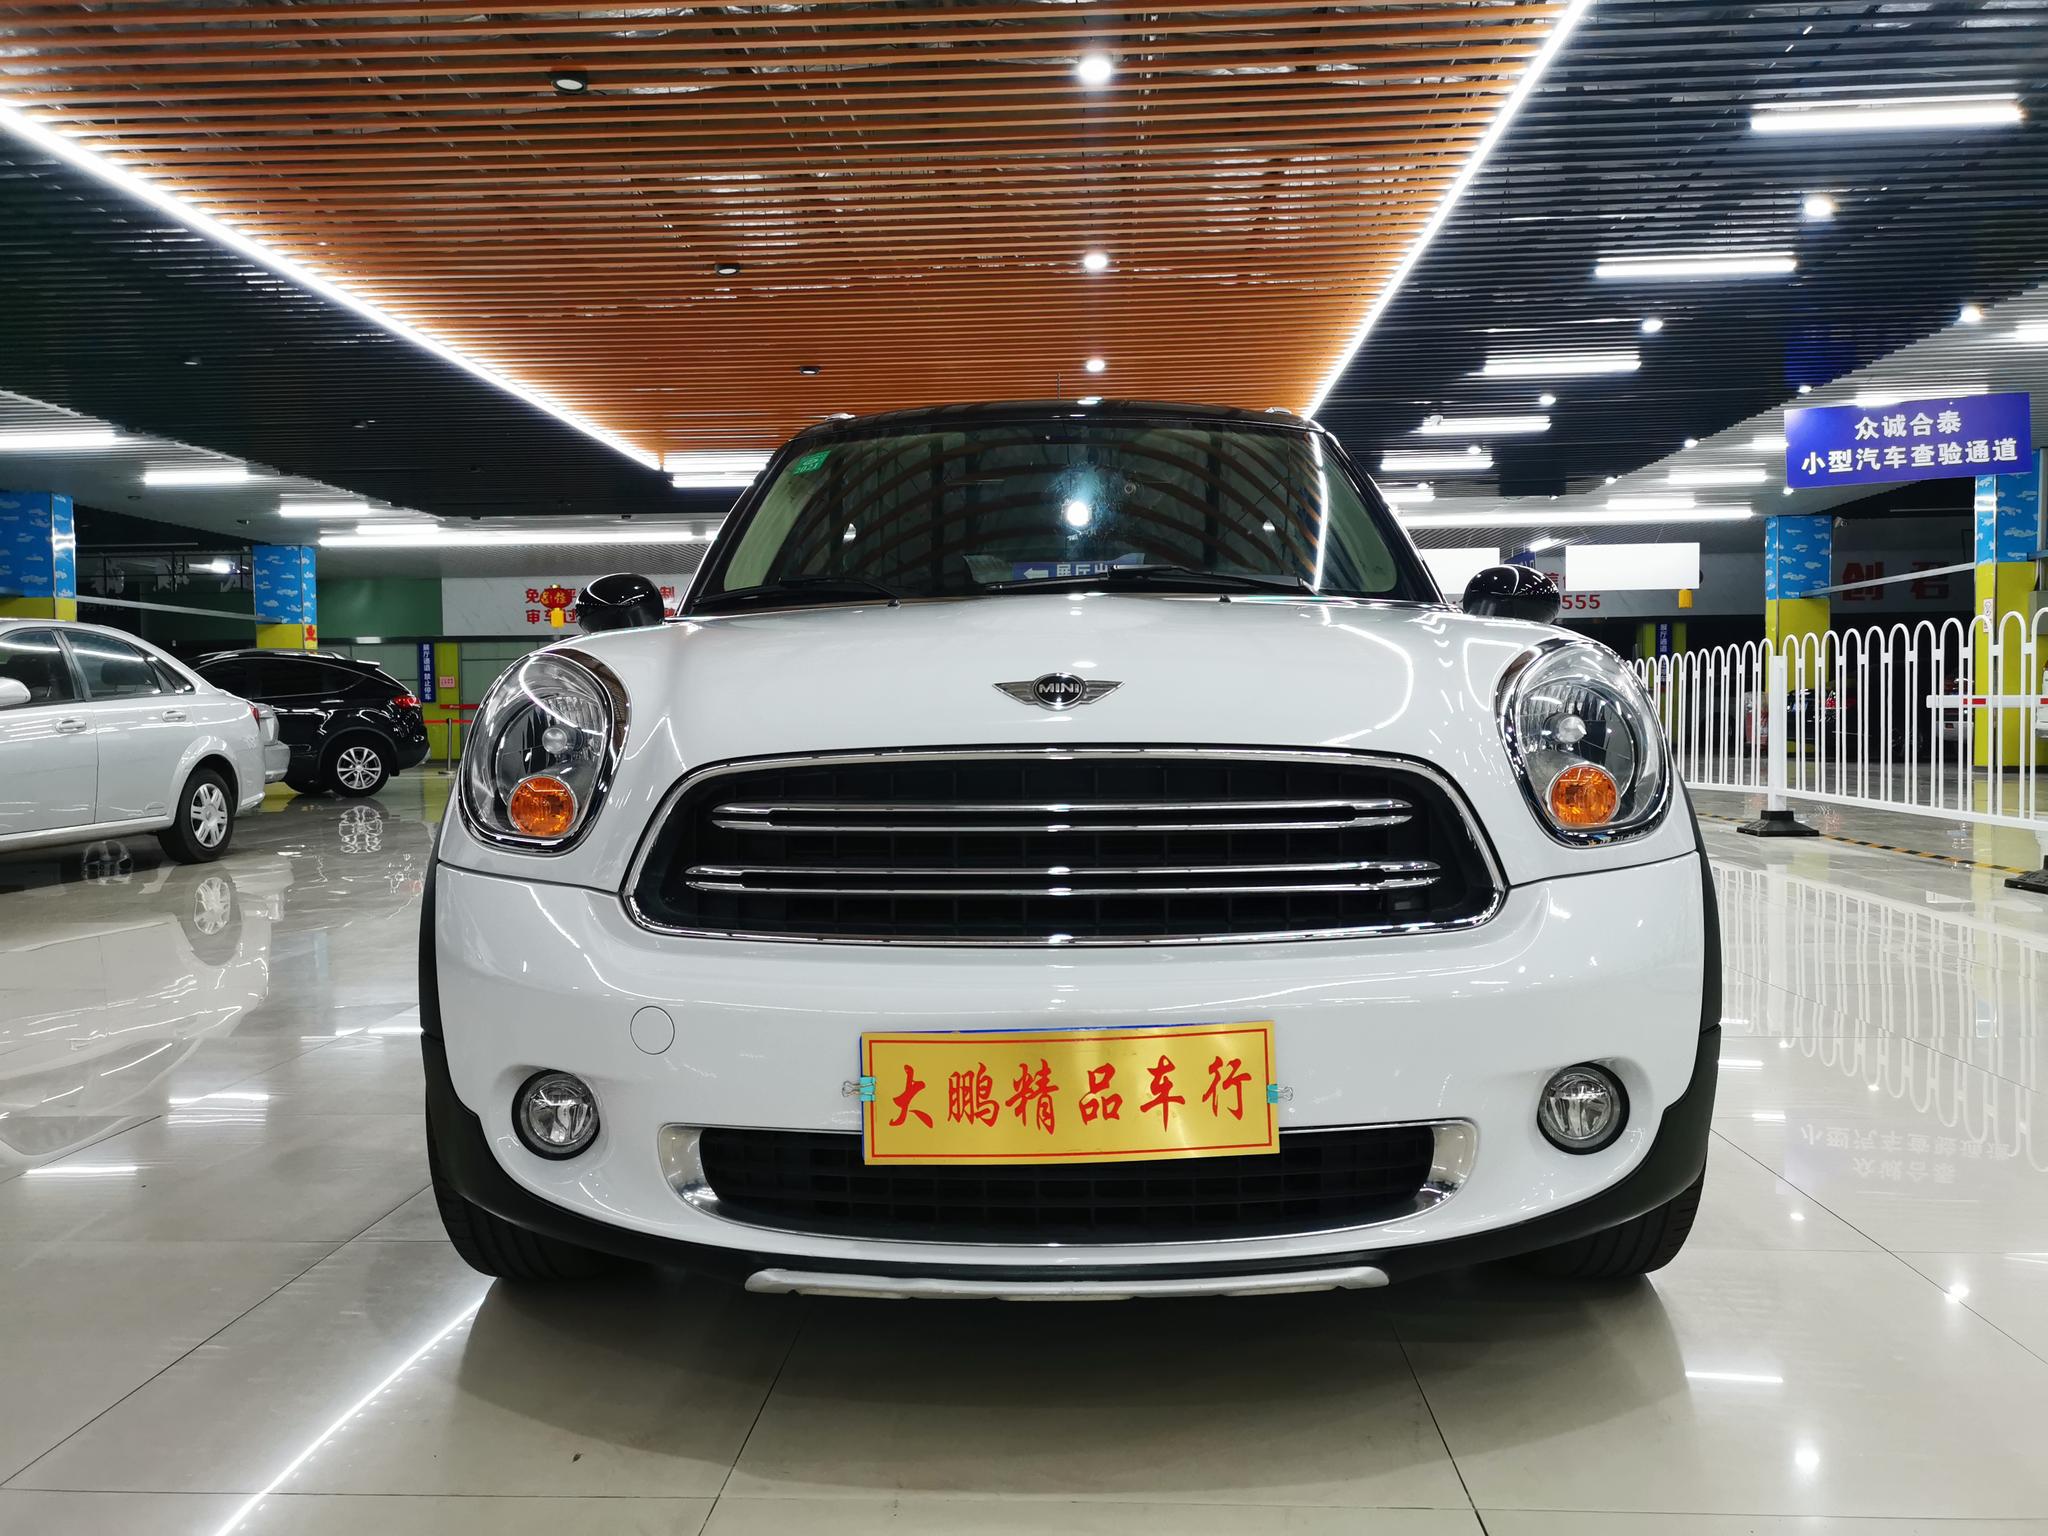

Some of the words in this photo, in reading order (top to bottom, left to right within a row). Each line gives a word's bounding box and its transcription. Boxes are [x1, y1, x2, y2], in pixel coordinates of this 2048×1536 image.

[1855, 410, 1962, 441] 众诚合泰
[1801, 437, 2018, 475] 小型汽车查验通道
[1038, 682, 1081, 694] MINI
[889, 1053, 1253, 1135] 大鹏精品车行
